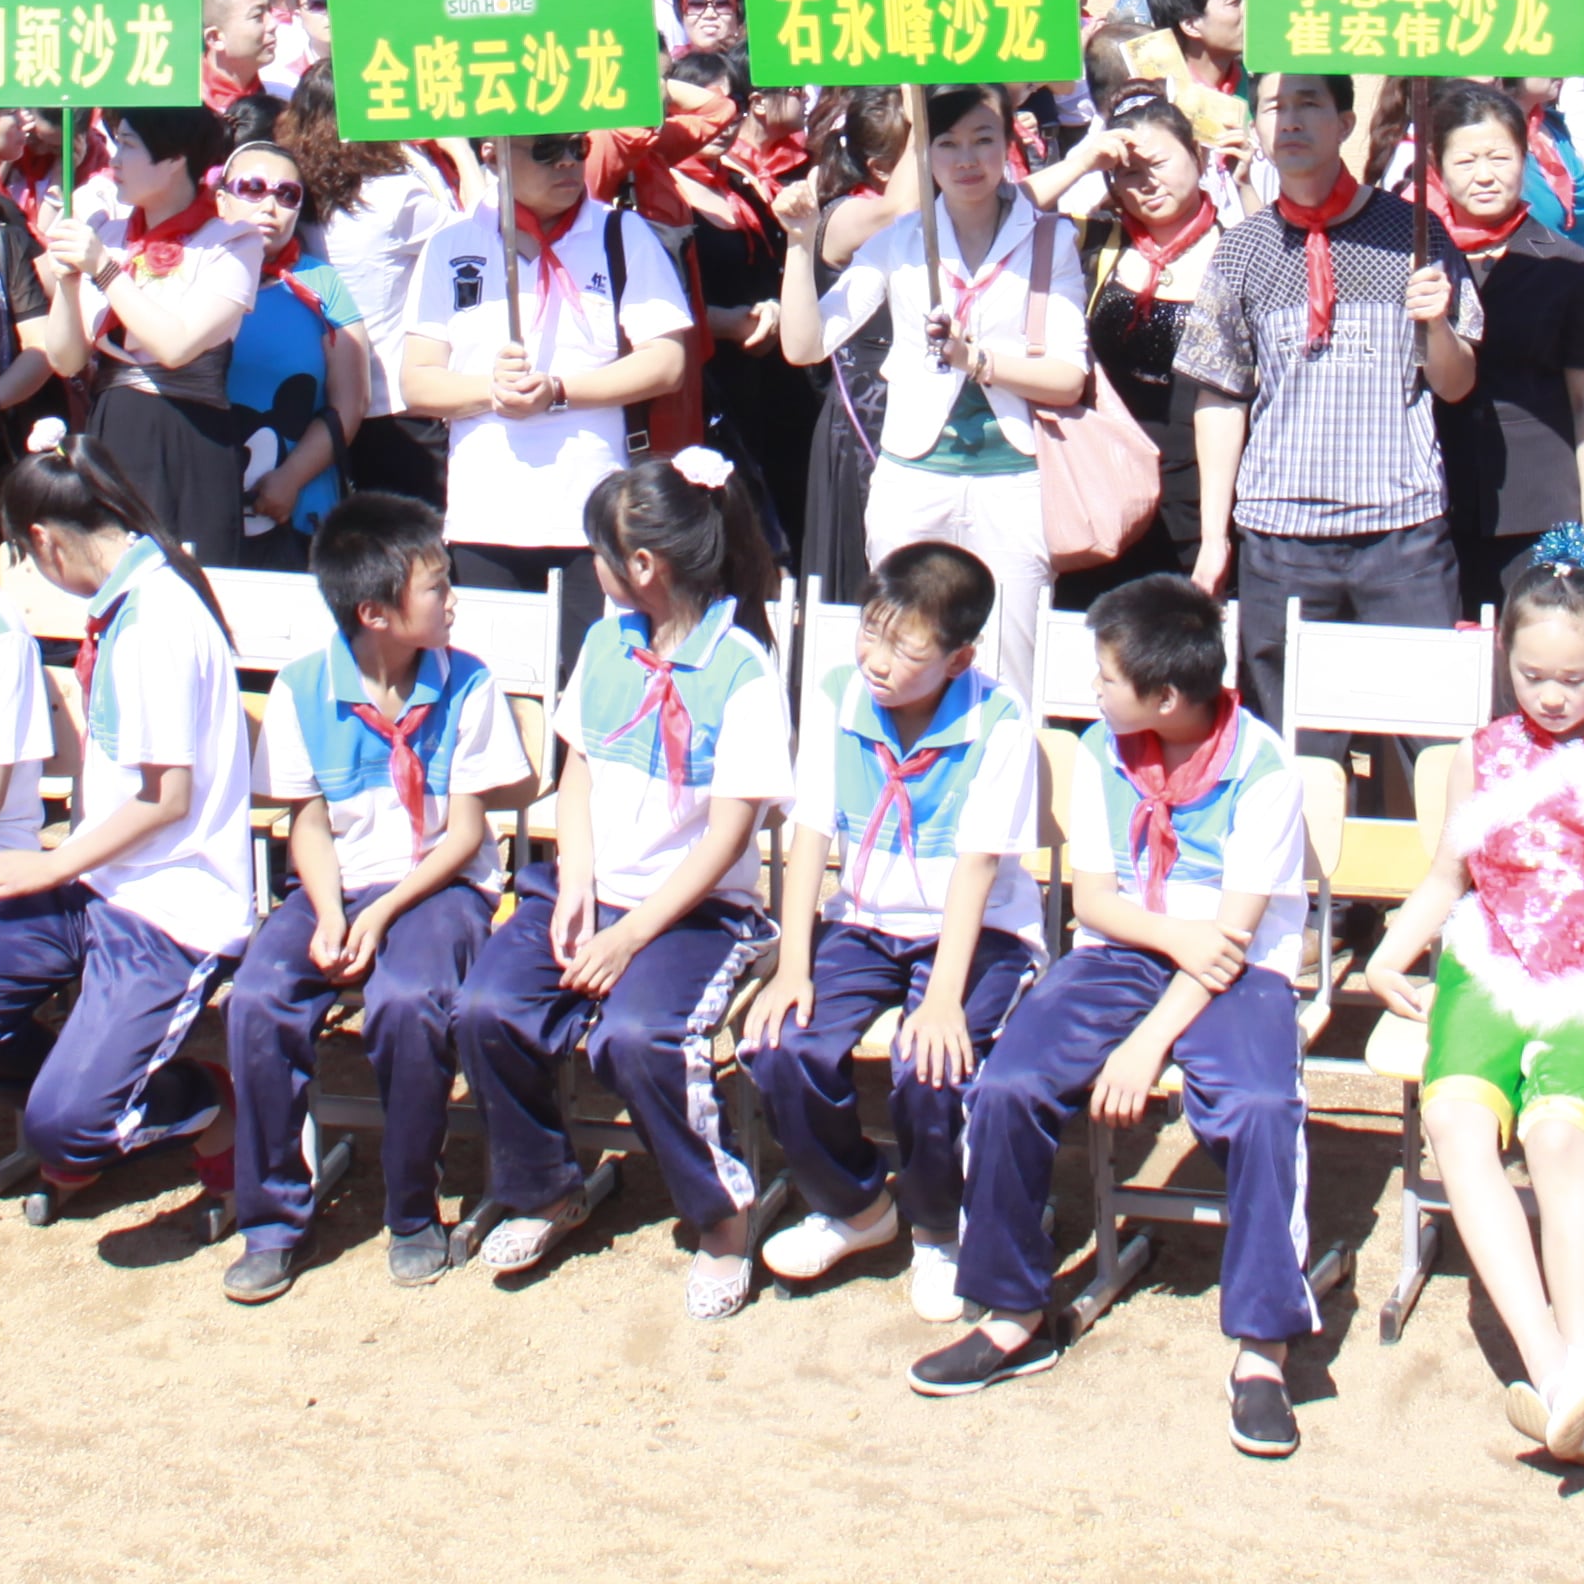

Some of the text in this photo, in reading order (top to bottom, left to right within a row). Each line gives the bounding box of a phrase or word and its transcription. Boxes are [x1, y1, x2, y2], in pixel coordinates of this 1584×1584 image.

[448, 0, 481, 14] SUN
[1285, 10, 1442, 57] 崔宏伟
[361, 29, 628, 121] 全晓云沙龙
